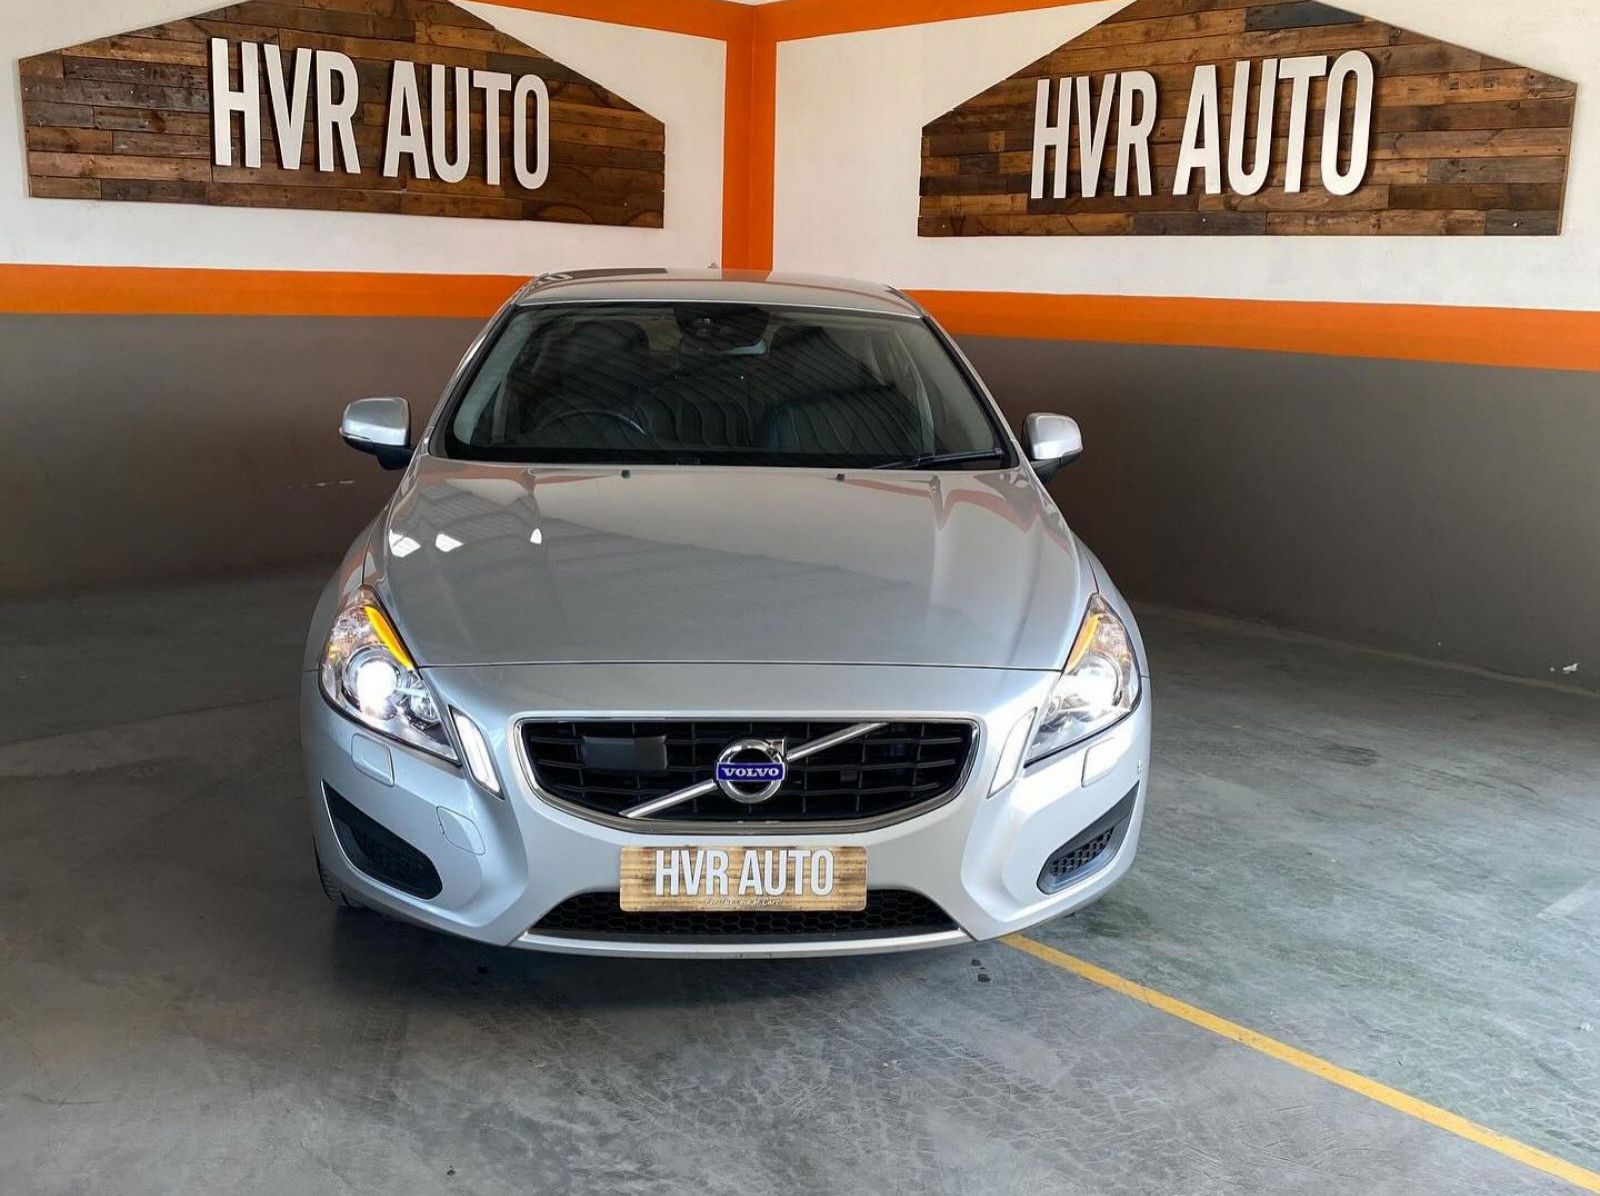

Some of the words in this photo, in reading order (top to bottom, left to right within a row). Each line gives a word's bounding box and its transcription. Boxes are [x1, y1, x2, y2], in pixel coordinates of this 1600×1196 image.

[211, 38, 360, 174] HVR
[383, 61, 550, 189] AUTO
[1031, 71, 1157, 199] HVR
[1172, 50, 1373, 196] AUTO
[721, 767, 779, 777] VOLVO
[655, 849, 729, 896] HVR
[738, 849, 834, 896] AUTO
